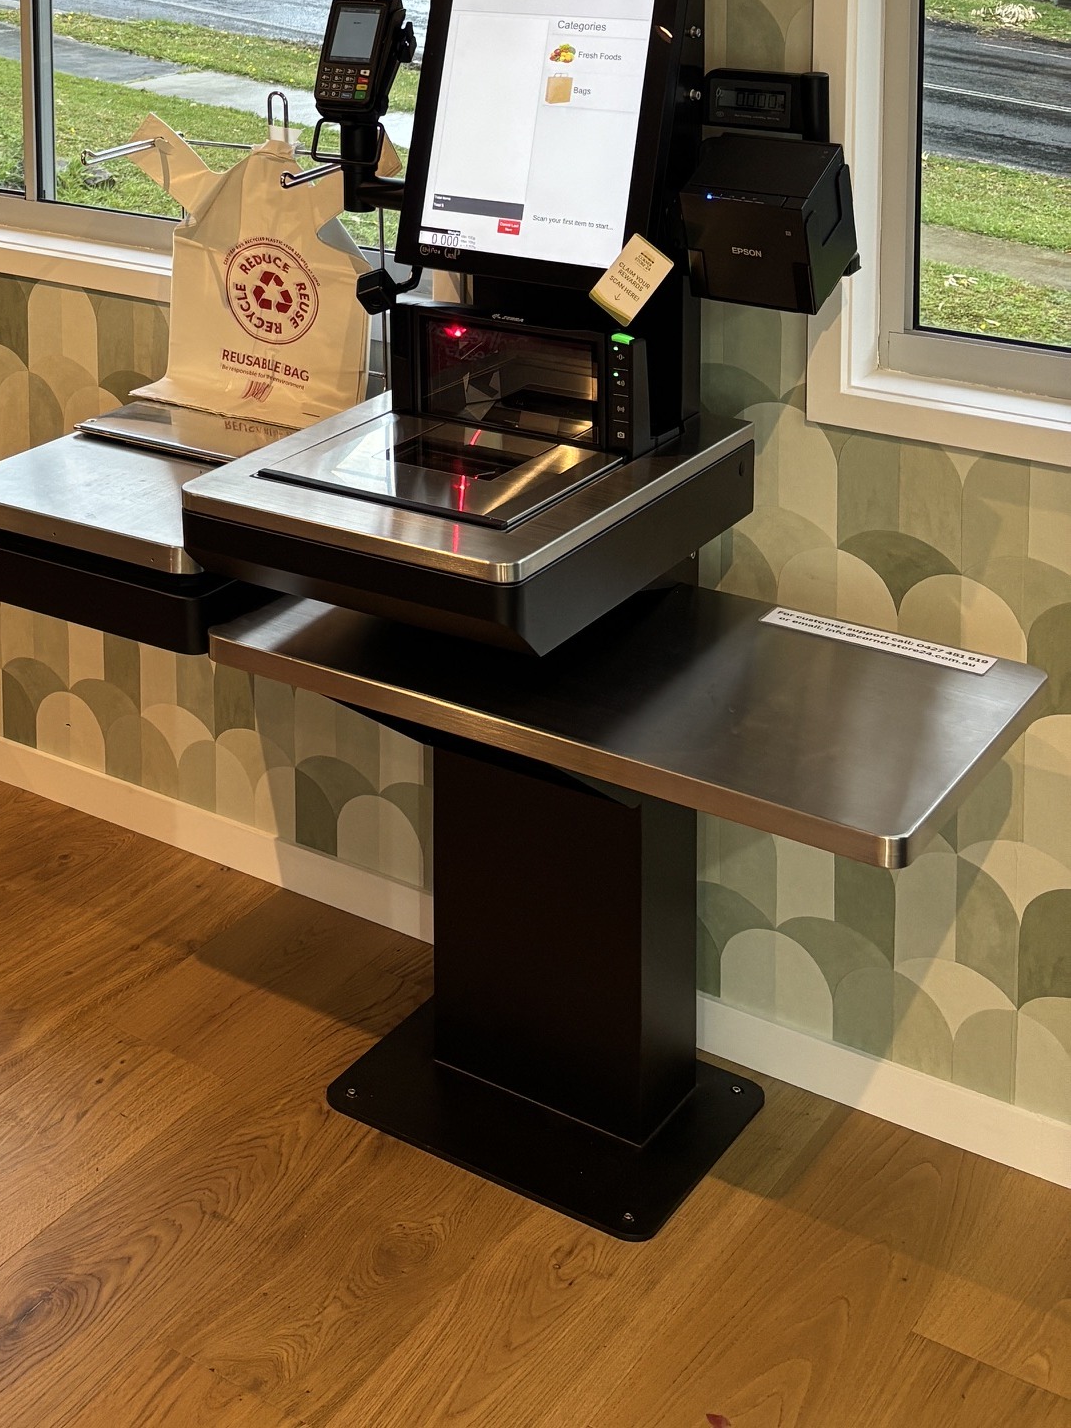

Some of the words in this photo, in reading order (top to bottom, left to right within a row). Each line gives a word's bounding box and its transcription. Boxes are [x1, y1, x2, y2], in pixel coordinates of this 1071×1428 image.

[557, 20, 607, 32] Categories
[578, 51, 598, 60] Fresh
[599, 52, 622, 61] Foods
[573, 86, 591, 96] Bags
[532, 214, 548, 222] Scan
[239, 253, 291, 275] REDUCE
[732, 246, 762, 258] EPSON
[609, 275, 625, 290] SCAN
[624, 287, 640, 302] HERE!
[618, 270, 644, 292] REWARDS
[619, 262, 636, 278] CLAIM
[636, 275, 651, 290] YOUR
[235, 283, 282, 334] RECYCLE
[289, 282, 310, 329] REUSE
[222, 349, 281, 373] REUSABLE
[283, 365, 309, 382] BAG
[229, 365, 258, 377] responsible
[273, 377, 305, 390] environment
[792, 620, 824, 630] email:
[825, 627, 976, 668] info@cornerstore24.com.au
[796, 615, 846, 630] customer
[847, 627, 889, 639] support
[891, 638, 914, 646] call:
[917, 643, 944, 653] 0427
